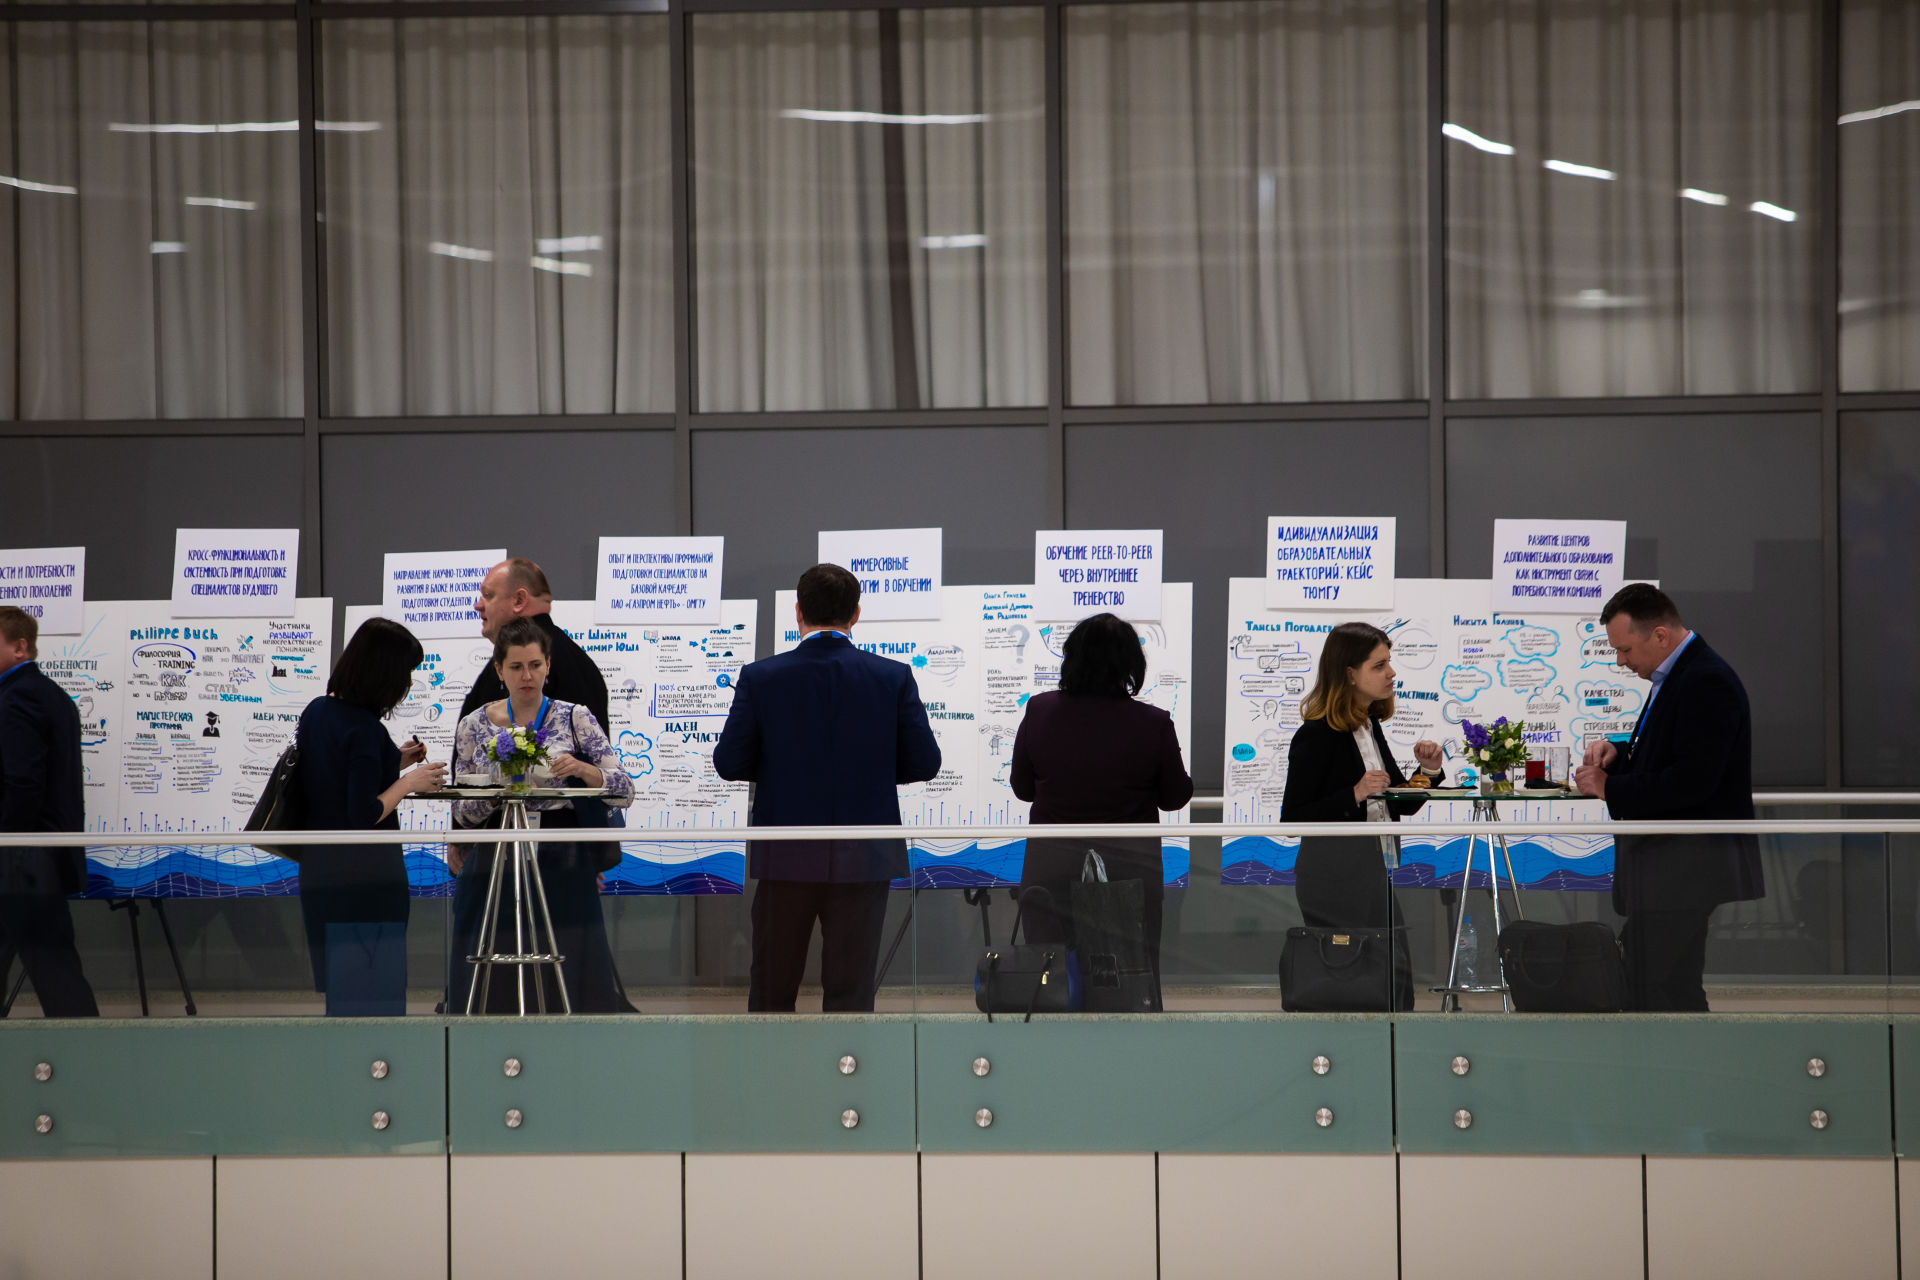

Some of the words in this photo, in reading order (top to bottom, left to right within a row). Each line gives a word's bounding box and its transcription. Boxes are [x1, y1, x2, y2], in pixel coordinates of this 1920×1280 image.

[1278, 525, 1378, 541] ИДИВИДУАЛИЗАЦИЯ
[1528, 534, 1559, 546] РАЗВИТИЕ
[1561, 535, 1590, 547] ЦЕНТРОВ
[280, 550, 286, 560] И
[608, 554, 626, 564] ОПЫТ
[626, 554, 631, 564] И
[632, 554, 674, 564] ПЕРСПЕКТИВЫ
[674, 552, 714, 564] ПРОФИЛЬНОЙ
[1046, 546, 1088, 560] ОБУЧЕНИЕ
[1092, 545, 1152, 560] PEER-TO-PEER
[1277, 546, 1372, 560] ОБРАЗОВАТЕЛЬНЫХ
[1504, 552, 1567, 564] ДОПОЛНИТЕЛЬНОГО
[1568, 552, 1613, 564] ОБРАЗОВАНИЯ
[851, 556, 909, 572] ИММЕРСИВНЫЕ
[18, 566, 24, 579] И
[25, 564, 76, 578] ПОТРЕБНОСТИ
[184, 567, 228, 578] СИСТЕМНОСТЬ
[230, 567, 242, 578] ПРИ
[244, 567, 288, 580] ПОДГОТОВКЕ
[394, 569, 430, 580] НАПРАВЛЕНИЕ
[612, 569, 652, 580] ПОДГОТОВКИ
[654, 568, 698, 579] СПЕЦИАЛИСТОВ
[700, 569, 708, 578] НА
[1059, 568, 1084, 582] ЧЕРЕЗ
[1086, 568, 1138, 582] ВНУТРЕННЕЕ
[1277, 563, 1344, 580] ТРАЕКТОРИЙ:
[1347, 562, 1374, 579] КЕЙС
[1516, 569, 1530, 580] КАК
[1532, 569, 1572, 581] ИНСТРУМЕНТ
[1574, 570, 1593, 581] СВЯЗИ
[1594, 570, 1599, 581] С
[30, 584, 72, 598] ПОКОЛЕНИЯ
[191, 584, 240, 596] СПЕЦИАЛИСТОВ
[242, 584, 278, 597] БУДУЩЕГО
[397, 584, 424, 594] РАЗВИТИЯ
[426, 584, 430, 594] В
[430, 583, 448, 593] БЛОКЕ
[450, 582, 454, 592] И
[630, 582, 657, 594] БАЗОВОЙ
[658, 584, 688, 594] КАФЕДРЕ
[884, 579, 890, 592] В
[892, 578, 932, 592] ОБУЧЕНИИ
[1512, 585, 1566, 598] ПОТРЕБНОСТЯМИ
[1566, 585, 1602, 598] КОМПАНИЙ
[1073, 591, 1125, 606] ТРЕНЕРСТВО
[1303, 586, 1340, 600] ТЮМГУ
[402, 598, 438, 610] ПОДГОТОВКИ
[440, 596, 472, 608] СТУДЕНТОВ
[611, 599, 624, 609] ПАО
[686, 599, 706, 608] ОМГТУ
[404, 612, 428, 622] УЧАСТИЯ
[430, 612, 434, 622] В
[435, 610, 463, 622] ПРОЕКТАХ
[138, 650, 181, 658] ФИЛОСОФИЯ
[1584, 689, 1624, 698] КАЧЕСТВО
[665, 722, 698, 734] ИДЕИ
